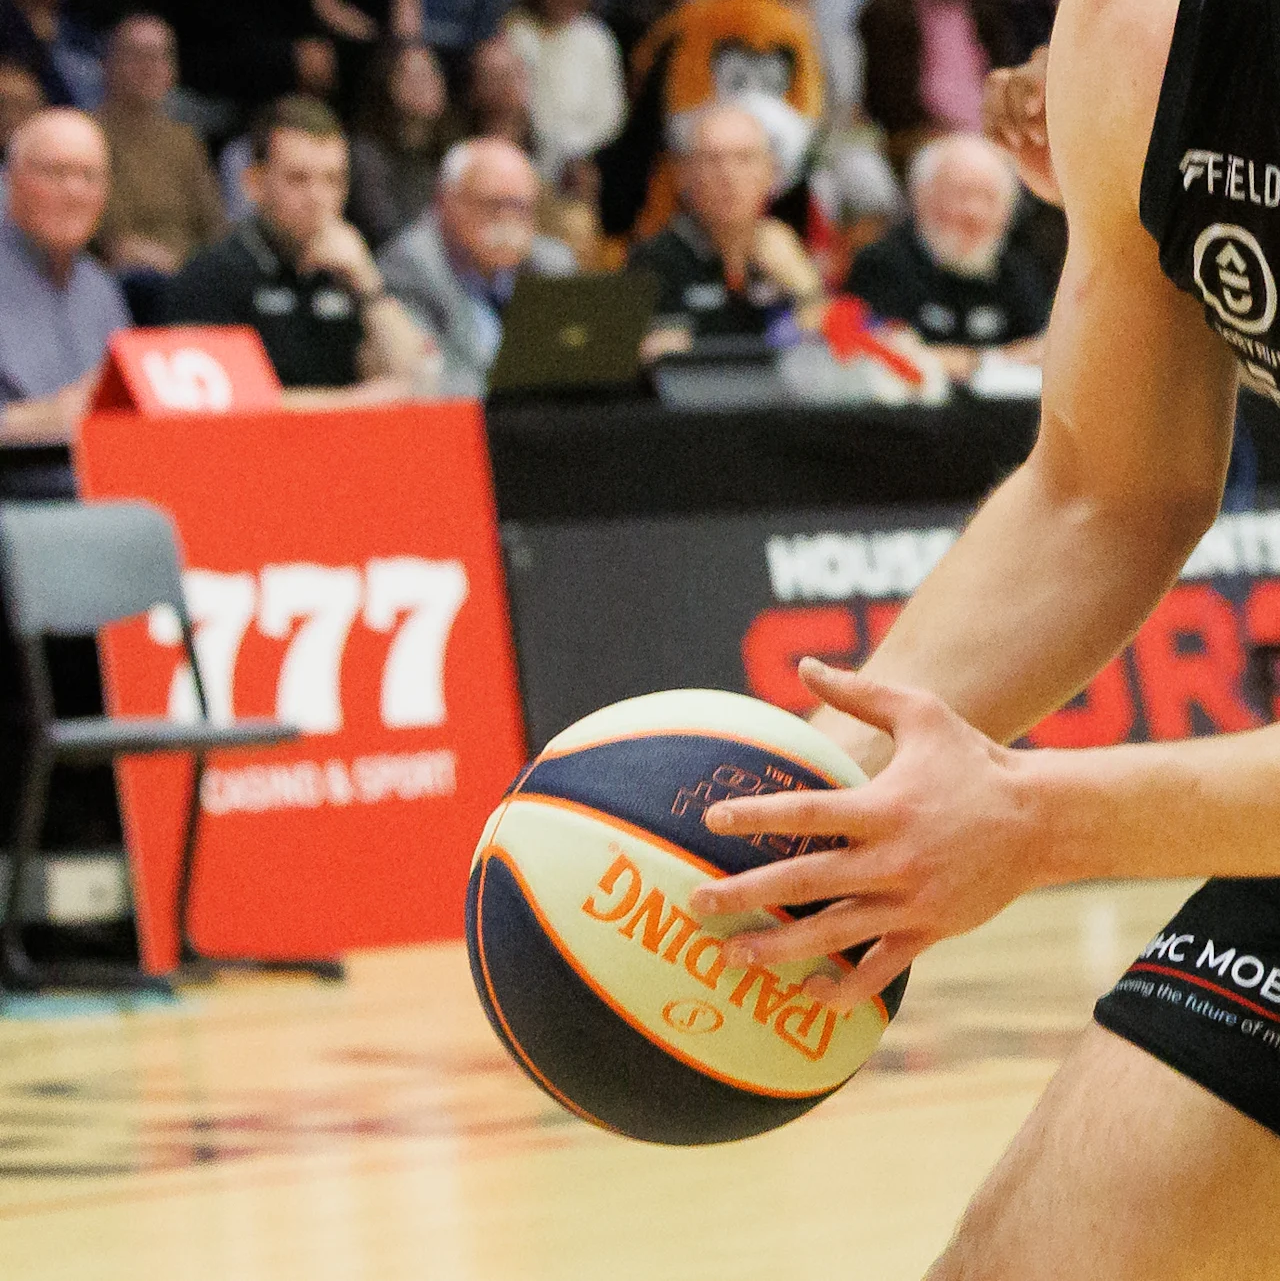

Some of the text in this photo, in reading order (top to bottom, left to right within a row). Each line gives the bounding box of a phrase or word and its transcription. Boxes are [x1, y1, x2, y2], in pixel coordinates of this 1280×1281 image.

[148, 557, 468, 733] 777
[1157, 982, 1183, 1005] the
[1185, 992, 1238, 1026] future
[1241, 1018, 1265, 1036] of
